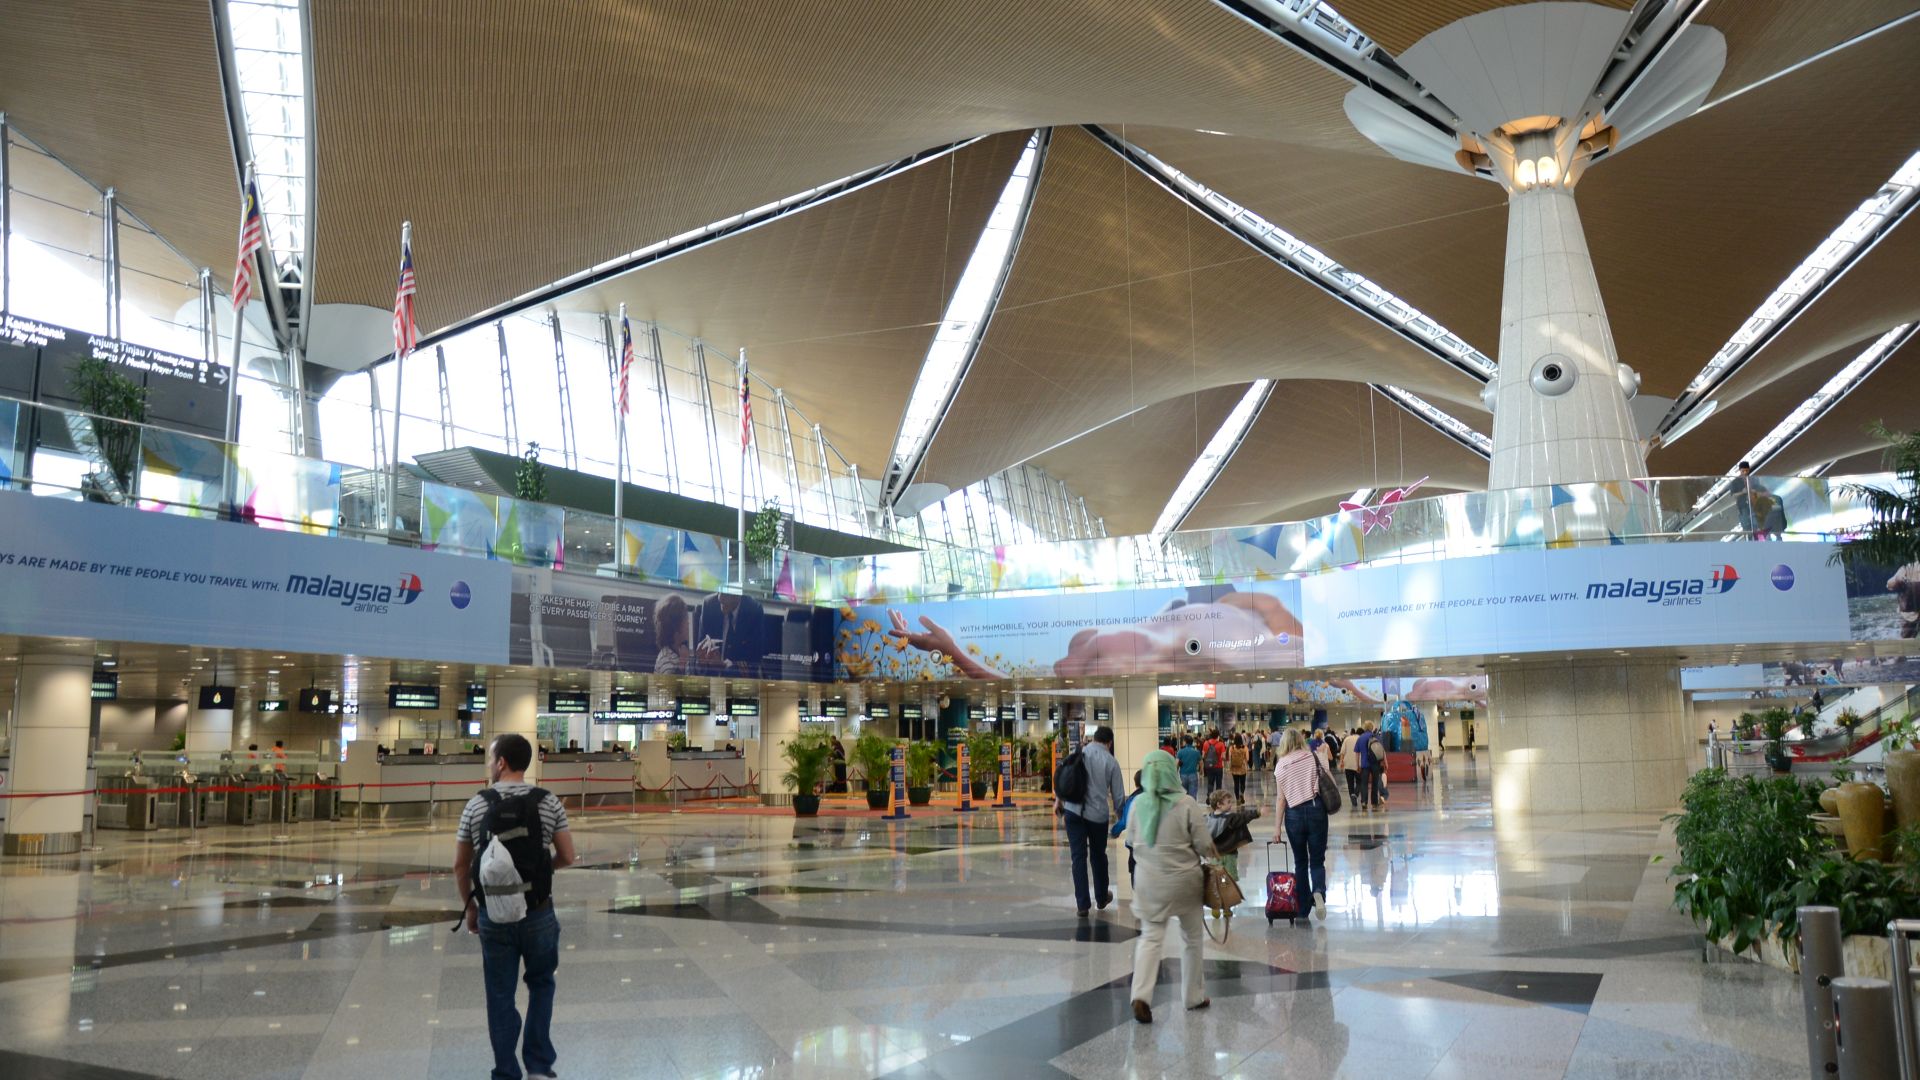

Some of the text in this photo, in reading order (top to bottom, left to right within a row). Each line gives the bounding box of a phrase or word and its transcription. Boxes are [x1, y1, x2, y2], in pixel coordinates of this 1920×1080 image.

[88, 335, 118, 353] Anjung
[120, 340, 145, 358] Tinjau
[151, 362, 173, 376] Prayer
[174, 368, 194, 380] Room
[18, 556, 47, 568] ARE
[49, 559, 88, 572] MADE
[90, 562, 107, 574] BY
[110, 564, 133, 577] THE
[135, 567, 181, 582] PEOPLE
[183, 572, 206, 584] YOU
[209, 575, 248, 589] TRAVEL
[252, 580, 280, 592] WITH.
[285, 574, 392, 606] malaysia
[1585, 578, 1704, 603] malaysia
[354, 602, 388, 614] airlines
[540, 595, 563, 606] MAKES
[564, 598, 575, 607] ME
[576, 599, 598, 610] HAPPY
[600, 602, 610, 611] TO
[612, 603, 620, 612] BE
[622, 604, 627, 612] A
[628, 604, 645, 614] PART
[542, 606, 565, 616] EVERY
[1337, 592, 1579, 619] JOURNEYS ARE MADE BY THE PEOPLE YOU TRAVEL WITH.
[1662, 596, 1702, 607] airlines
[960, 611, 1224, 633] WITH MHMOBILE, YOUR JOURNEYS BEGIN RIGHT WHERE YOU ARE.
[1208, 638, 1252, 650] malaysia
